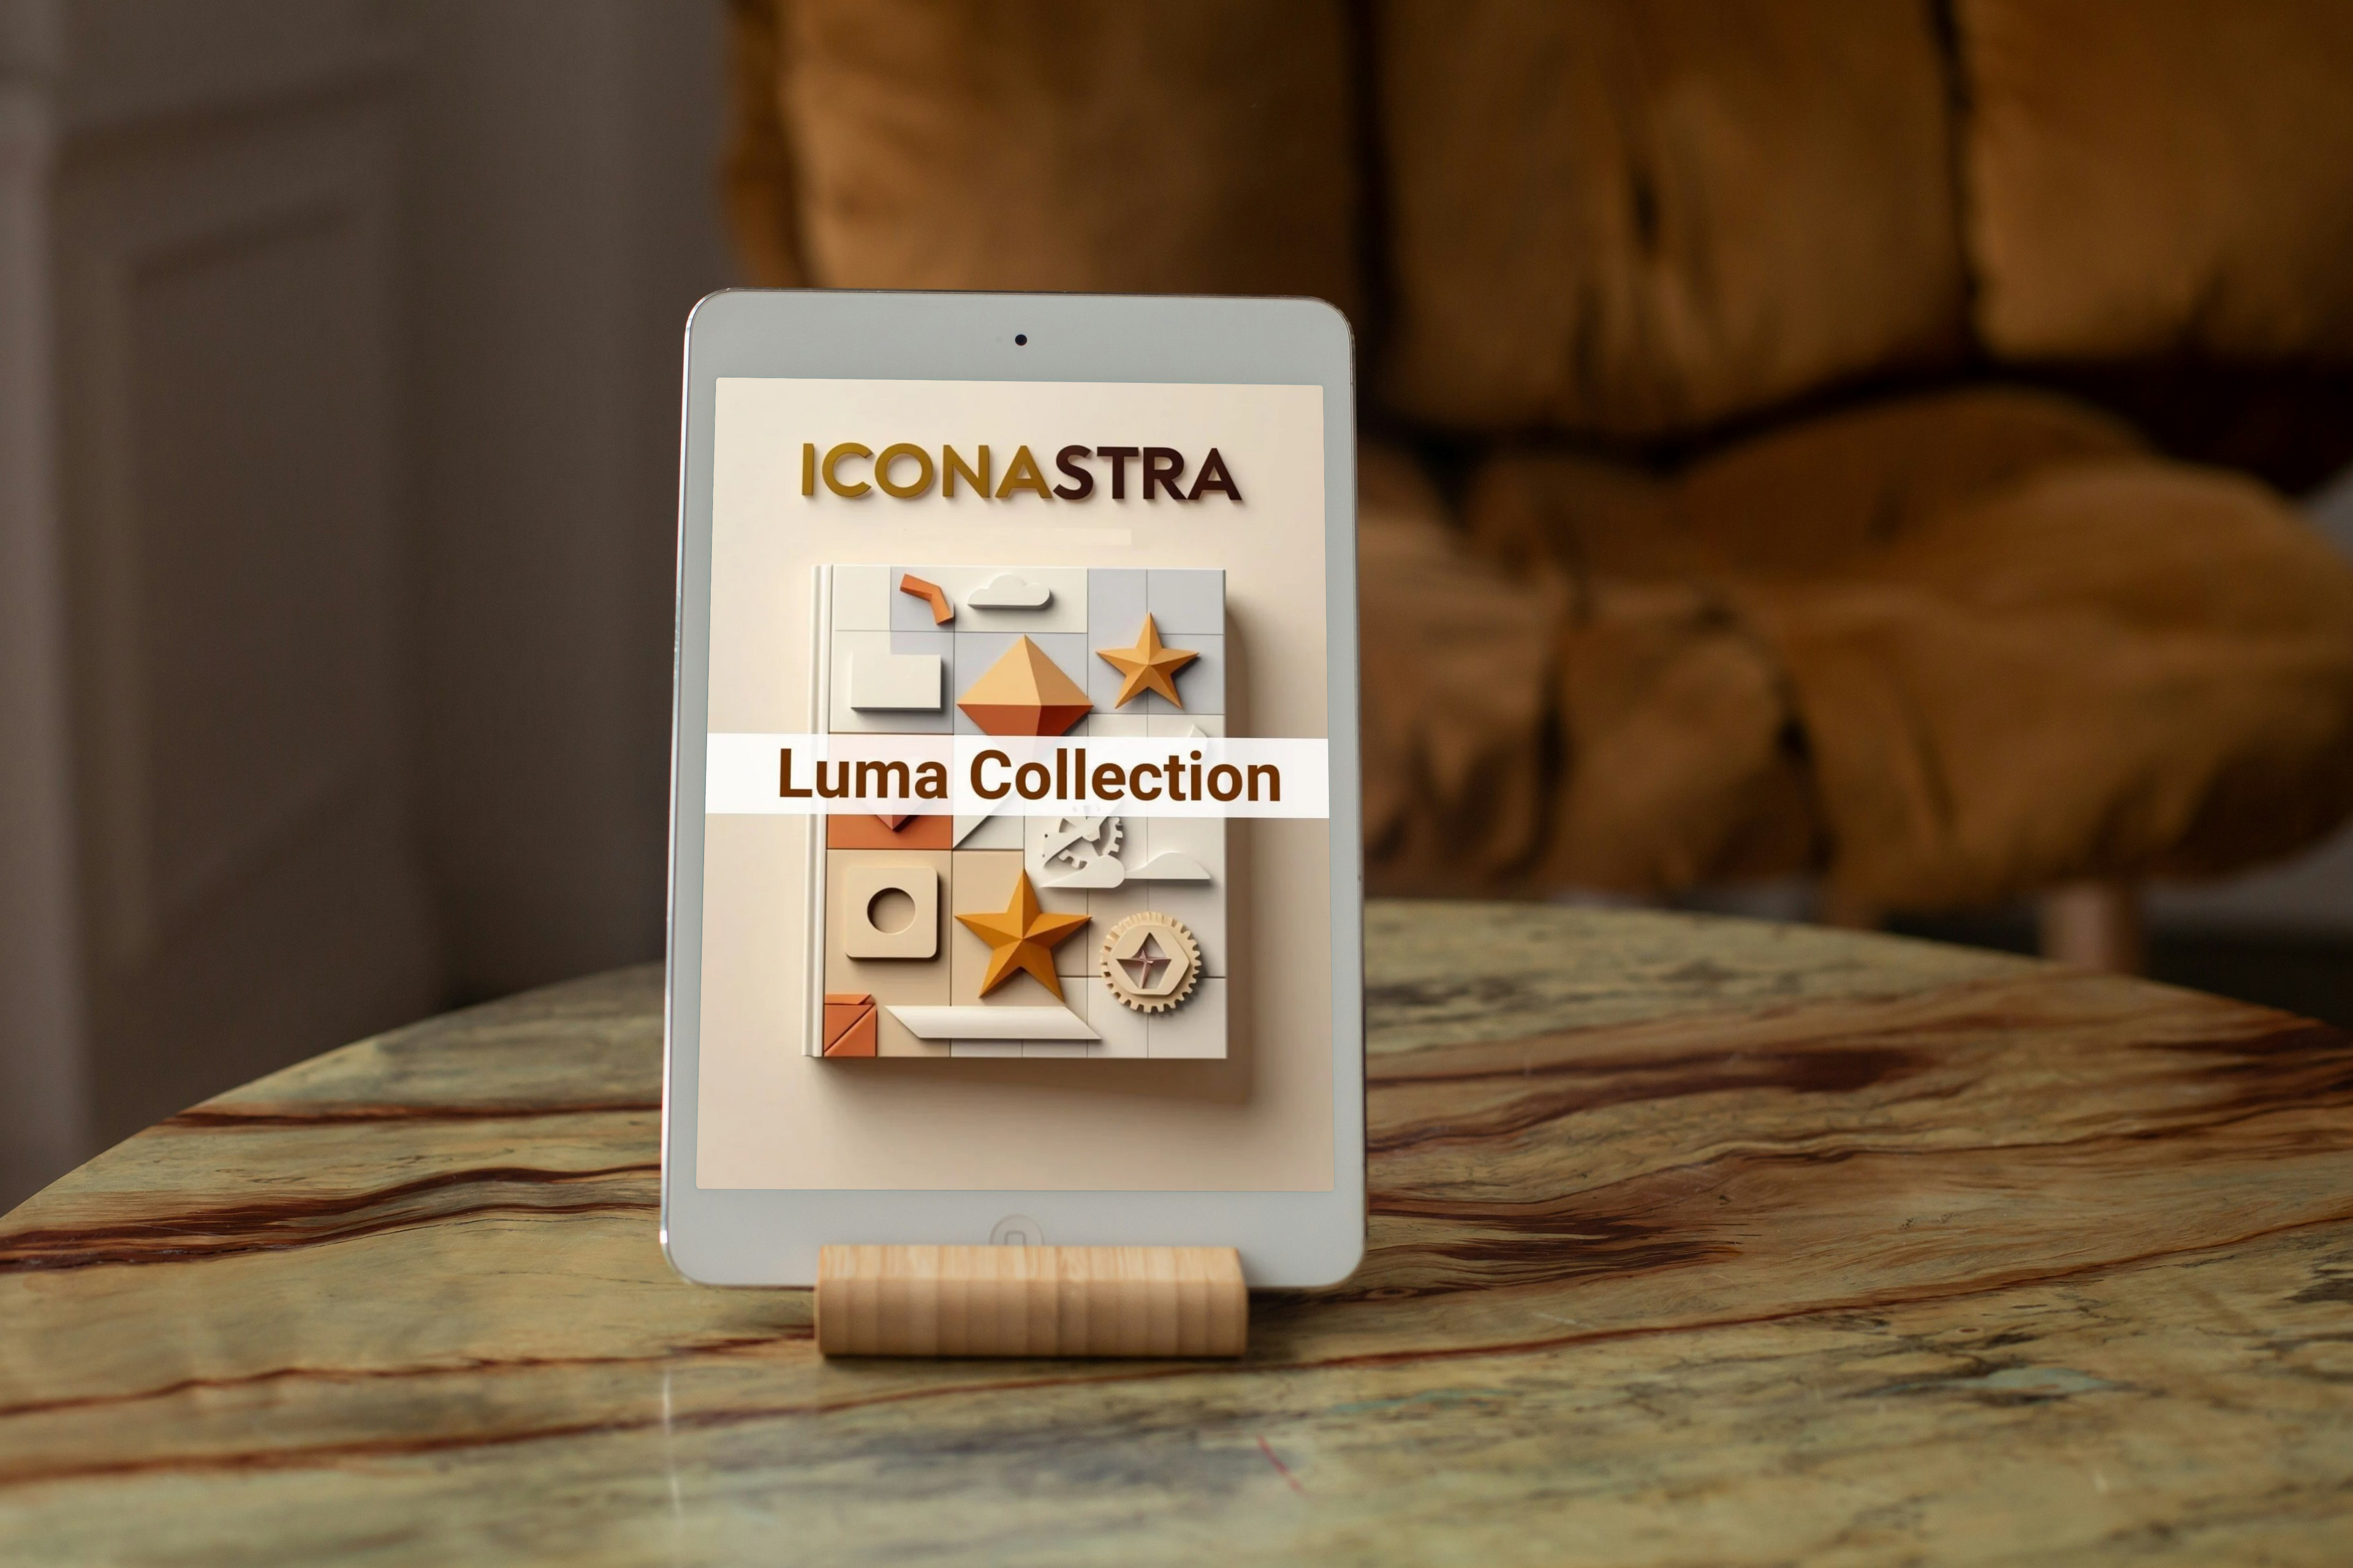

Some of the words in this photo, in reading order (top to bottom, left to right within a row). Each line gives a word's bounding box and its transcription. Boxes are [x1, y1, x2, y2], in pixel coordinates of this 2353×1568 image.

[801, 442, 1244, 504] ICONASTRA
[779, 748, 948, 800] Luma
[970, 748, 1281, 803] Collection
